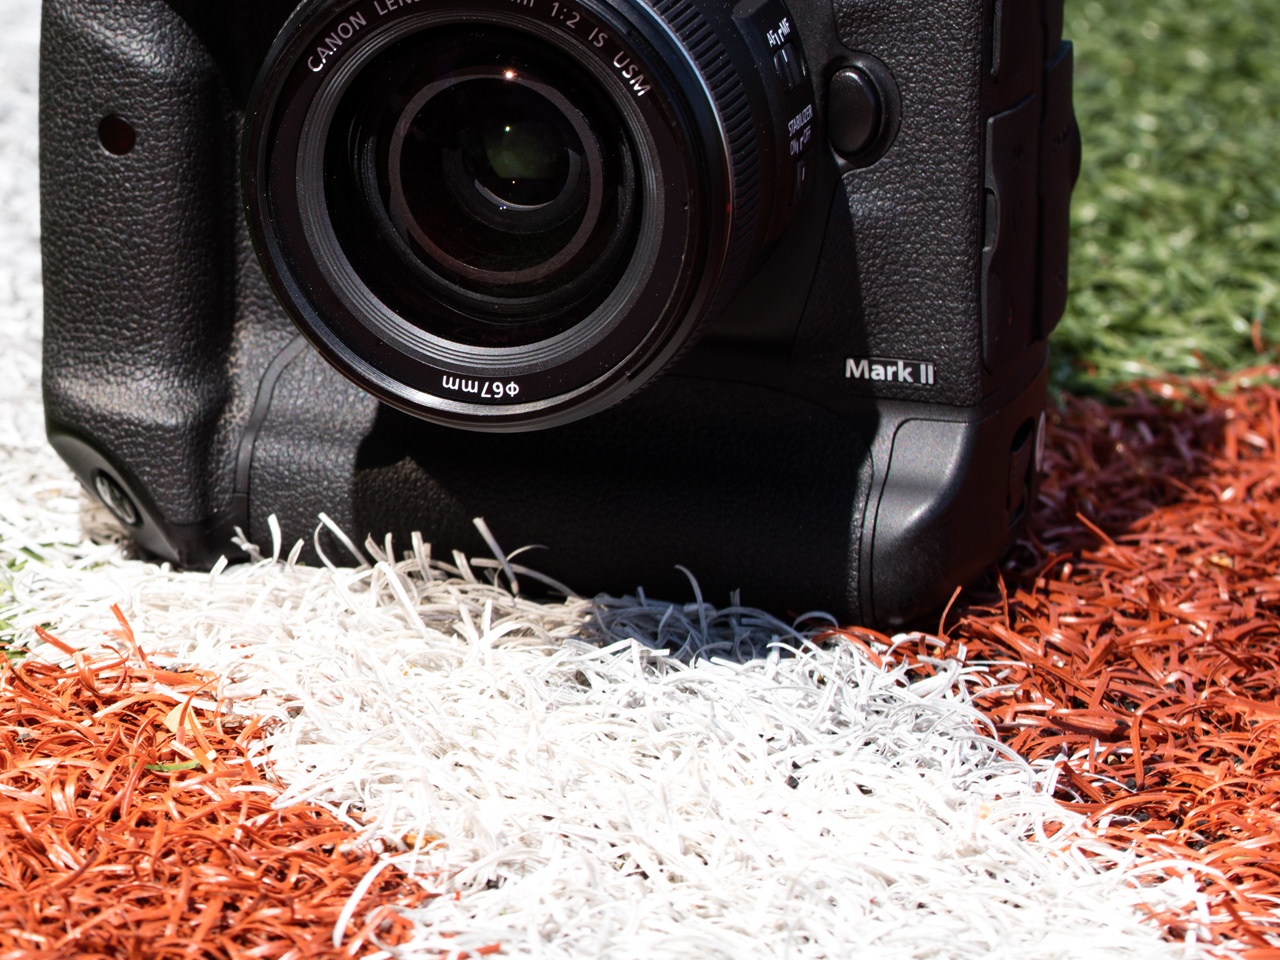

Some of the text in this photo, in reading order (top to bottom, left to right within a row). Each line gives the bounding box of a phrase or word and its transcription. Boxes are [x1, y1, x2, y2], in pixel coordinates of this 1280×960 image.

[307, 11, 368, 73] CANON
[550, 2, 580, 29] 1:2
[588, 27, 608, 48] IS
[613, 51, 652, 97] USM
[845, 358, 934, 385] Mark II
